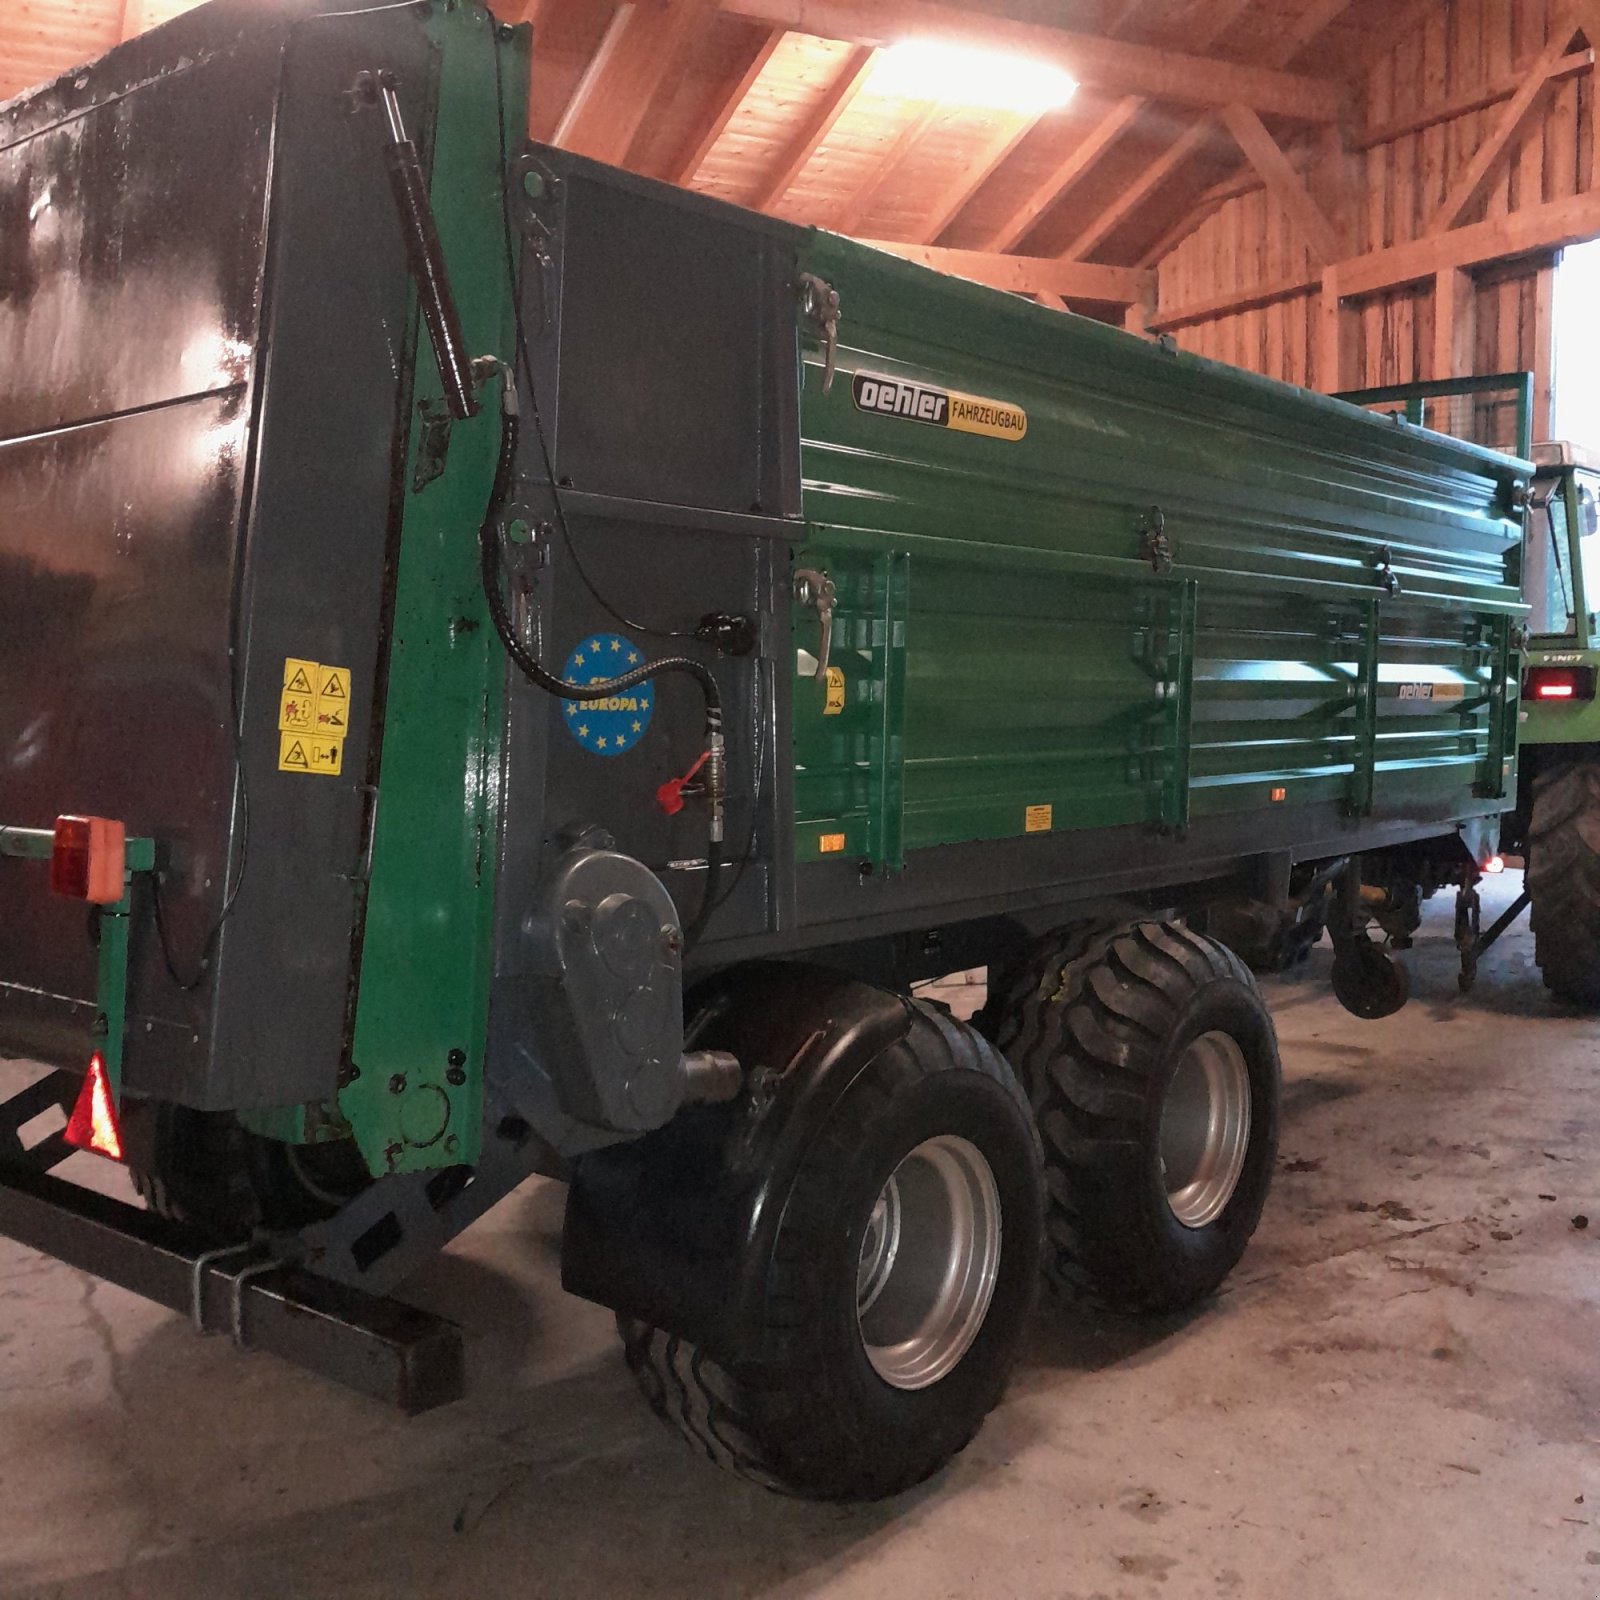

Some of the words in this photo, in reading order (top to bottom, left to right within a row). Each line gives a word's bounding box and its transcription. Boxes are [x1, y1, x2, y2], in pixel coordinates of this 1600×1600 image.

[859, 381, 947, 421] oehler
[952, 401, 1025, 431] FAHRZEUGBAU
[1399, 683, 1432, 699] oehler
[579, 697, 638, 711] EUROPA
